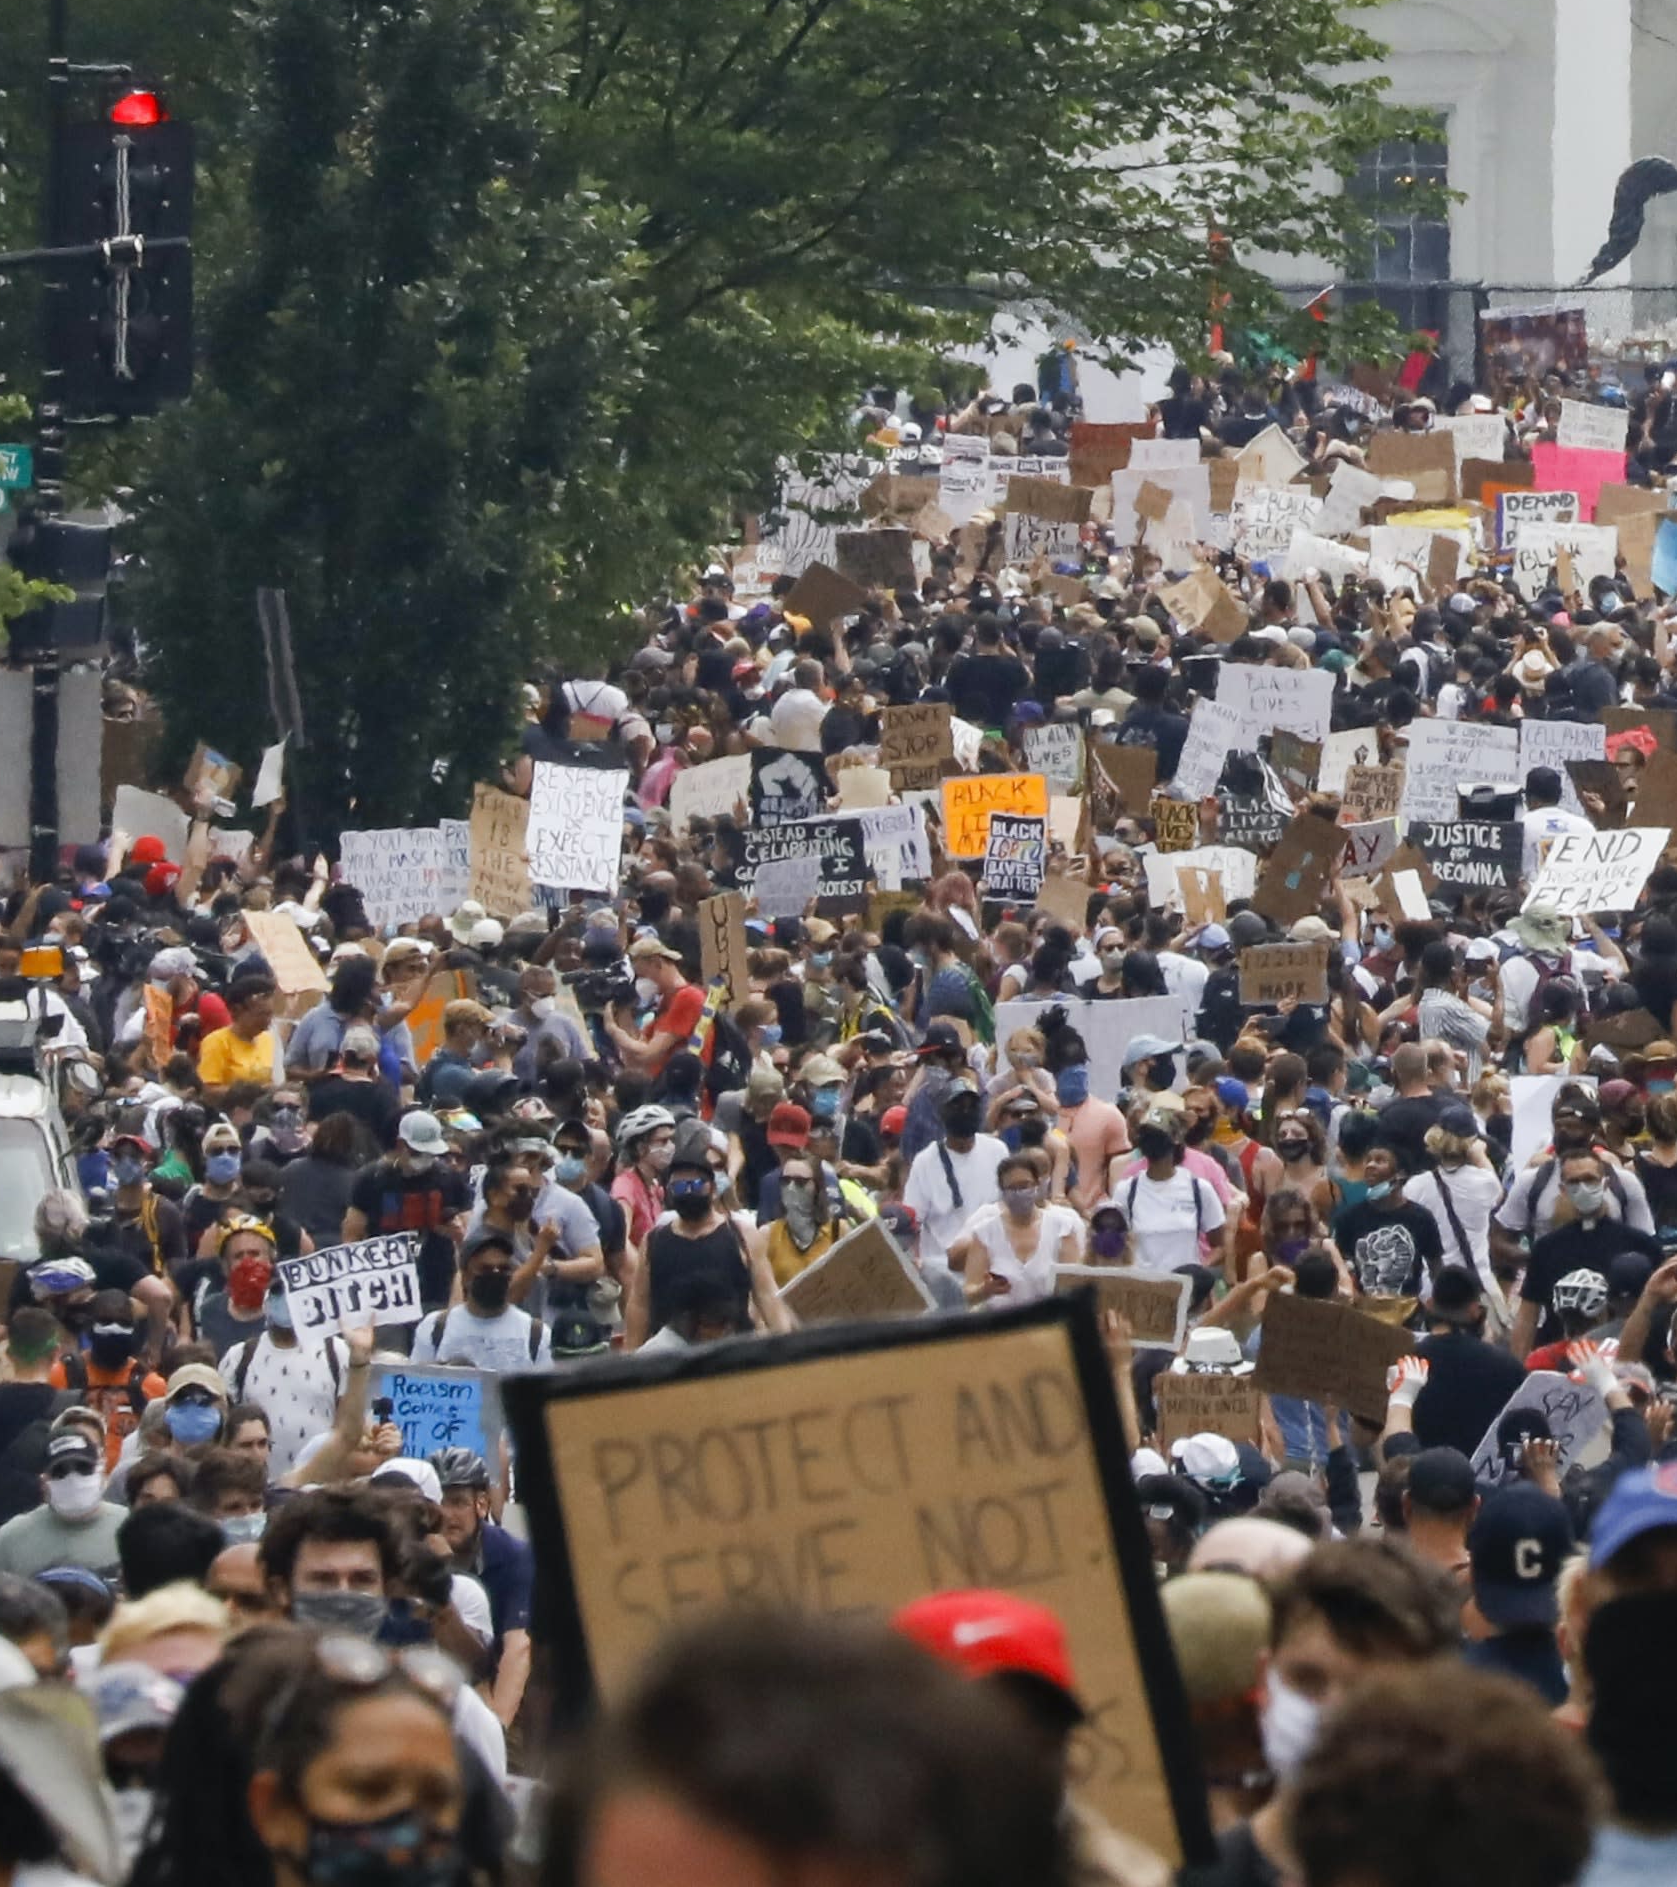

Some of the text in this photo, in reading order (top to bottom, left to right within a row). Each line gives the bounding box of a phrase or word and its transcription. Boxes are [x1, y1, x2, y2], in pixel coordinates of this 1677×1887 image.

[886, 735, 939, 760] STOP
[534, 764, 623, 795] RESPECT
[952, 779, 1028, 807] BLACK
[532, 789, 622, 824] EXISTENCE
[371, 832, 402, 851] YOU
[536, 829, 612, 855] EXPECT
[742, 824, 838, 845] INSTEAD OF
[992, 821, 1044, 840] BLACK
[1424, 823, 1502, 851] JUSTICE
[388, 849, 428, 867] MASK
[478, 850, 515, 872] THE
[1340, 833, 1381, 869] AY
[1554, 833, 1643, 864] END
[527, 851, 620, 886] RESISTANCE
[832, 857, 850, 874] I
[987, 860, 1040, 876] LIVES
[1430, 861, 1508, 888] REONNA
[814, 878, 864, 897] ROTEST
[987, 874, 1041, 894] MATTER
[1531, 881, 1618, 910] FEAR
[287, 1238, 407, 1289] BUNKER
[301, 1270, 414, 1328] BITCH
[393, 1373, 473, 1400] Racism
[953, 1369, 1083, 1468] AND
[1542, 1386, 1596, 1423] SAY
[432, 1419, 466, 1442] OF
[590, 1392, 915, 1545] PROTECT
[915, 1480, 1069, 1589] NOT
[612, 1517, 878, 1617] SERVE
[1515, 1539, 1542, 1578] C
